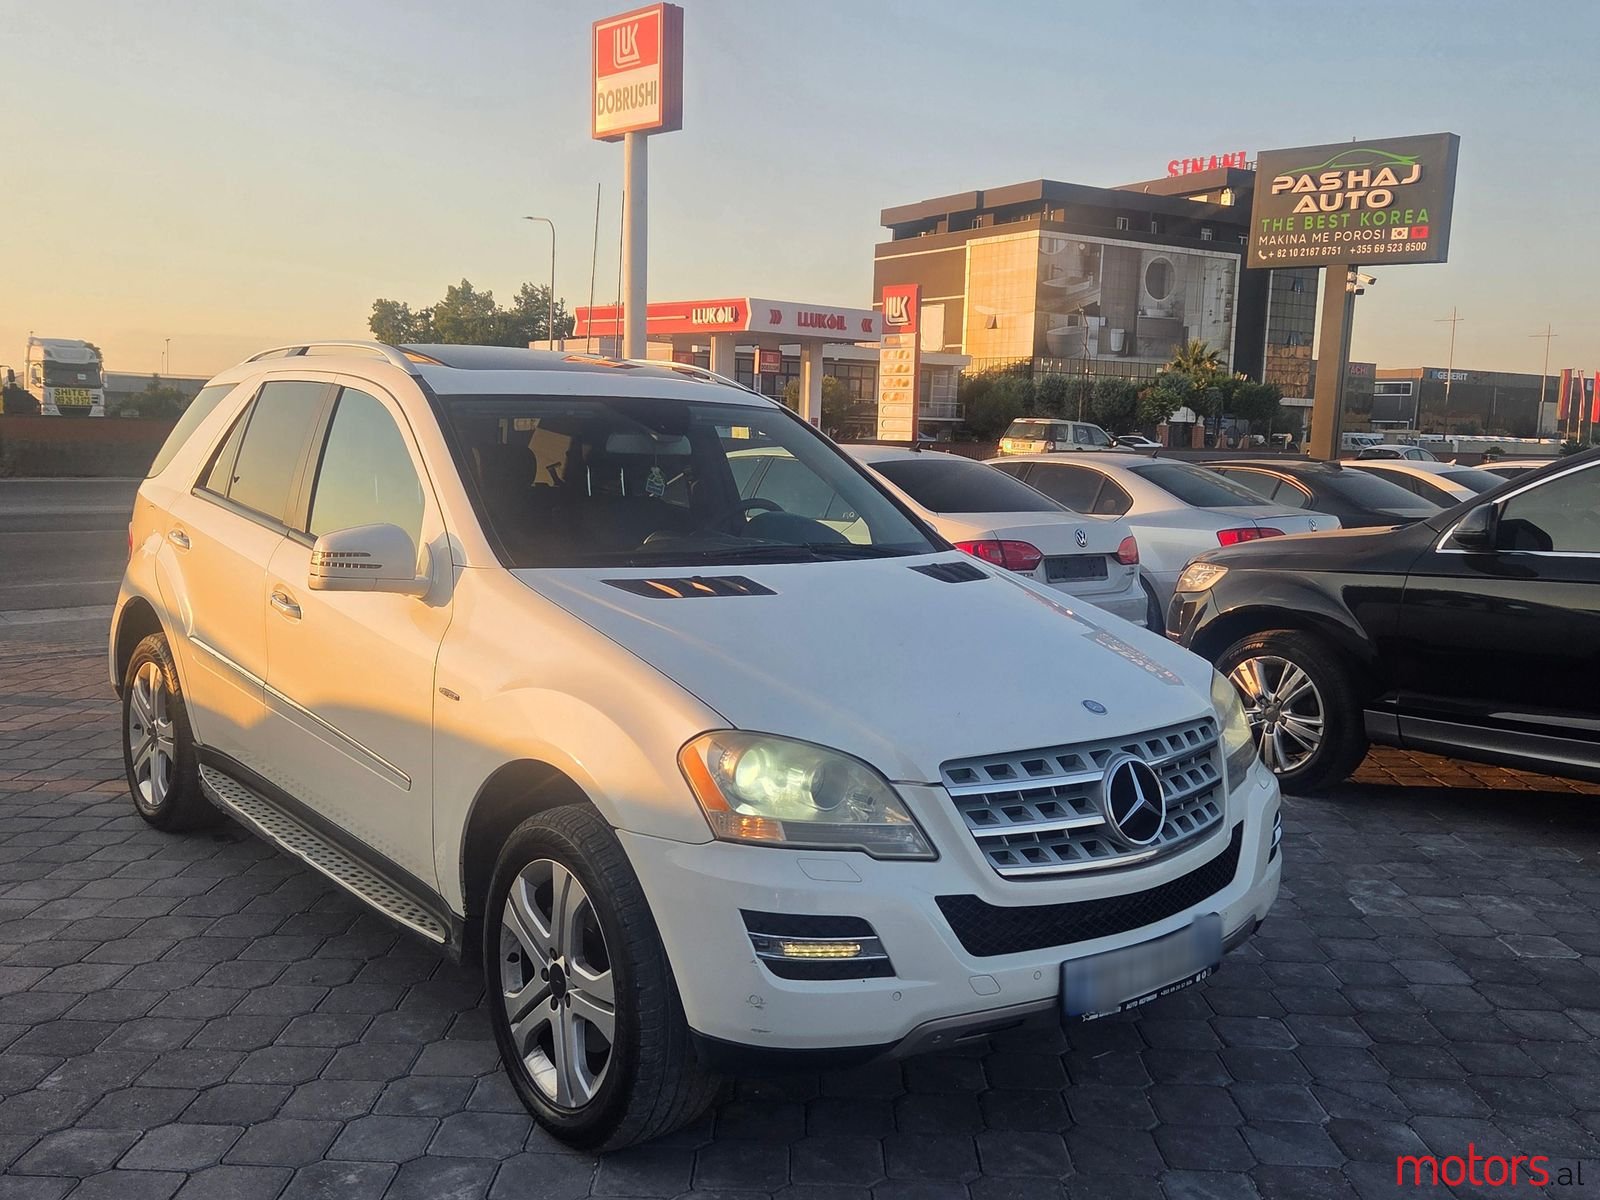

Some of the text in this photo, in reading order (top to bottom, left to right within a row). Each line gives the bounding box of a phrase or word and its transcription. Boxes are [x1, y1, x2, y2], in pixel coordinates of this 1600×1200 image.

[597, 80, 657, 116] DOBRUSHI
[1167, 151, 1246, 177] SINANI
[1271, 164, 1422, 195] PASHAJ
[1292, 189, 1394, 214] AUTO
[1261, 208, 1430, 233] THE BEST KOREA
[1258, 229, 1385, 246] MAKINA ME POROSI
[1277, 249, 1287, 258] 82
[1289, 248, 1299, 257] 10
[1387, 242, 1403, 253] 523
[54, 389, 90, 397] SHITET
